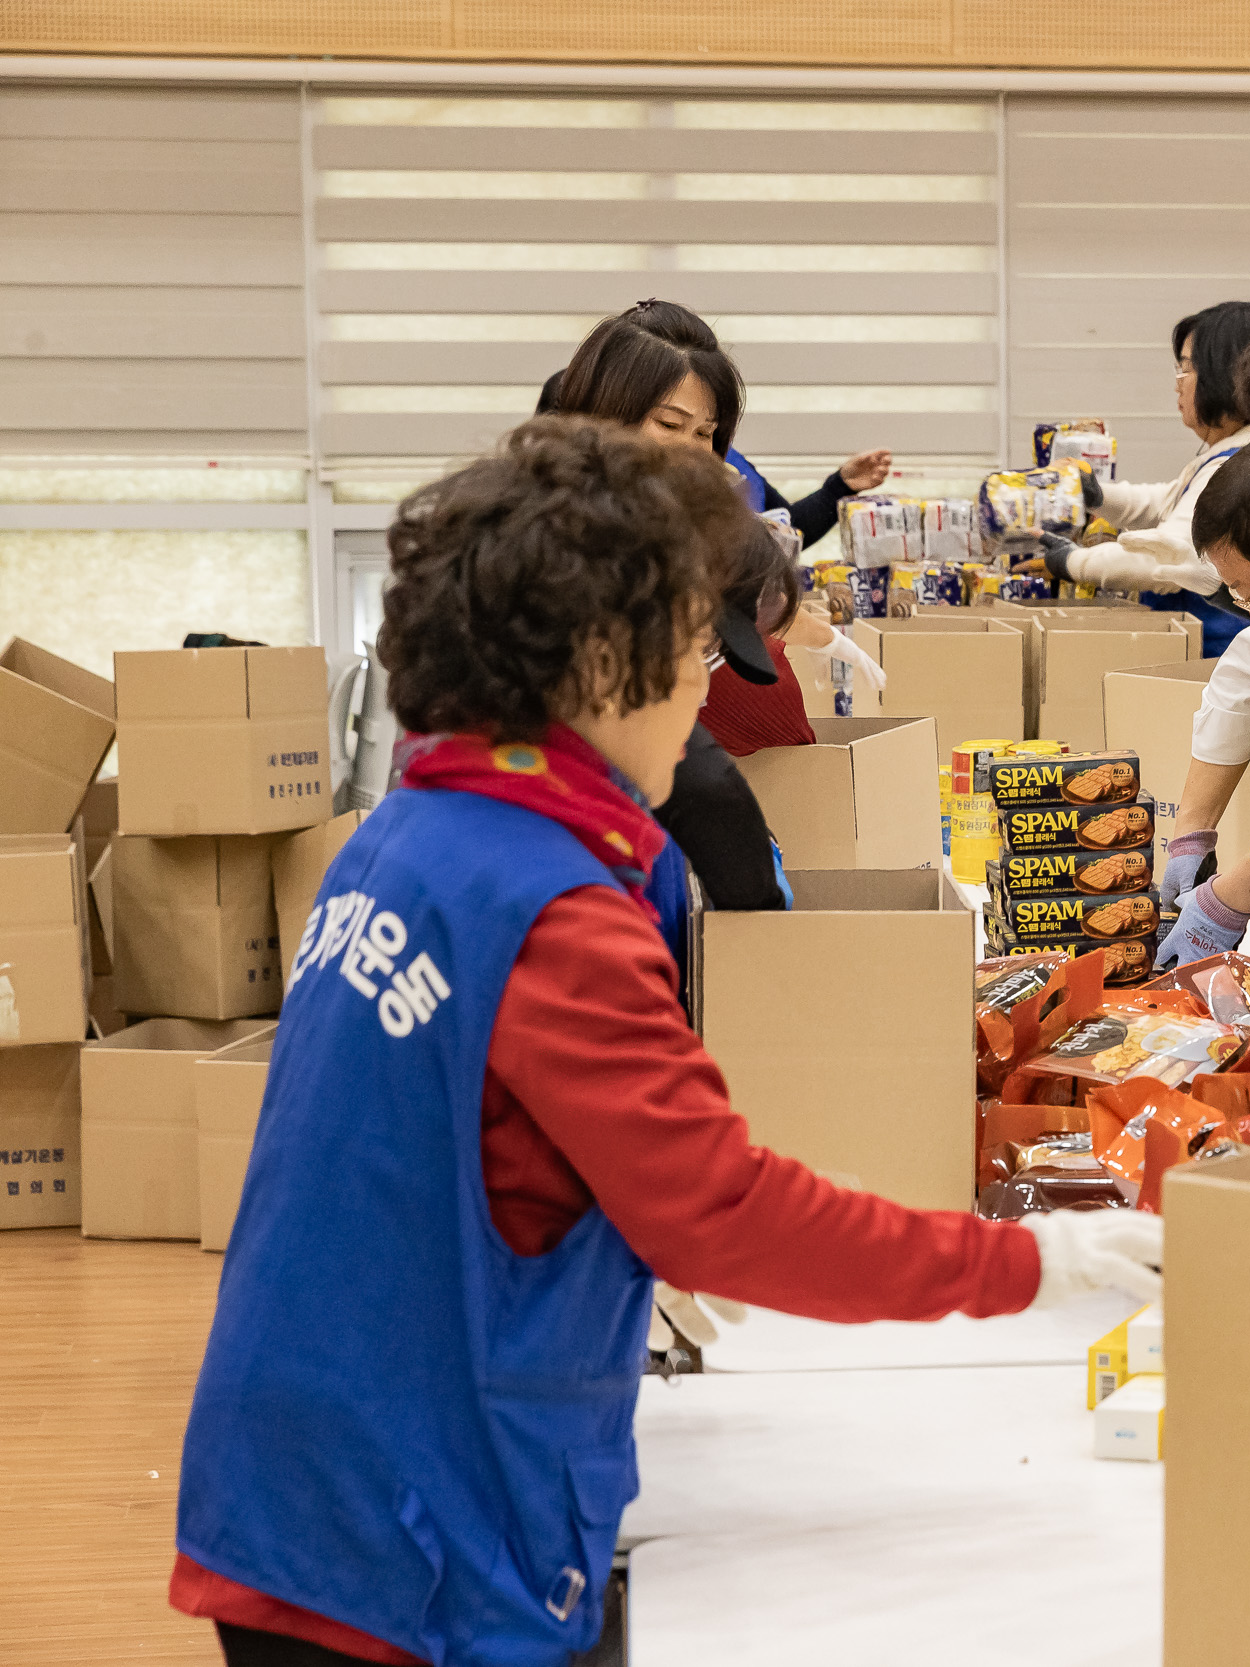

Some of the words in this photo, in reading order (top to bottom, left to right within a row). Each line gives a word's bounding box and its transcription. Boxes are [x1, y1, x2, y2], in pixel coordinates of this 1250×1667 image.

[995, 765, 1064, 788] SPAM
[996, 788, 1019, 799] 스팸
[1019, 787, 1042, 797] 클래식
[1011, 810, 1079, 834] SPAM
[1012, 833, 1034, 844] 스팸
[1034, 832, 1057, 843] 클래식
[1008, 855, 1076, 879] SPAM
[1125, 857, 1144, 865] No.1
[1009, 878, 1031, 889] 스팸
[1032, 877, 1054, 887] 클래식
[1016, 900, 1084, 923] SPAM
[1132, 902, 1151, 910] No.1
[1017, 923, 1039, 933] 스팸
[1040, 921, 1061, 932] 클래식
[1125, 946, 1143, 954] No.1
